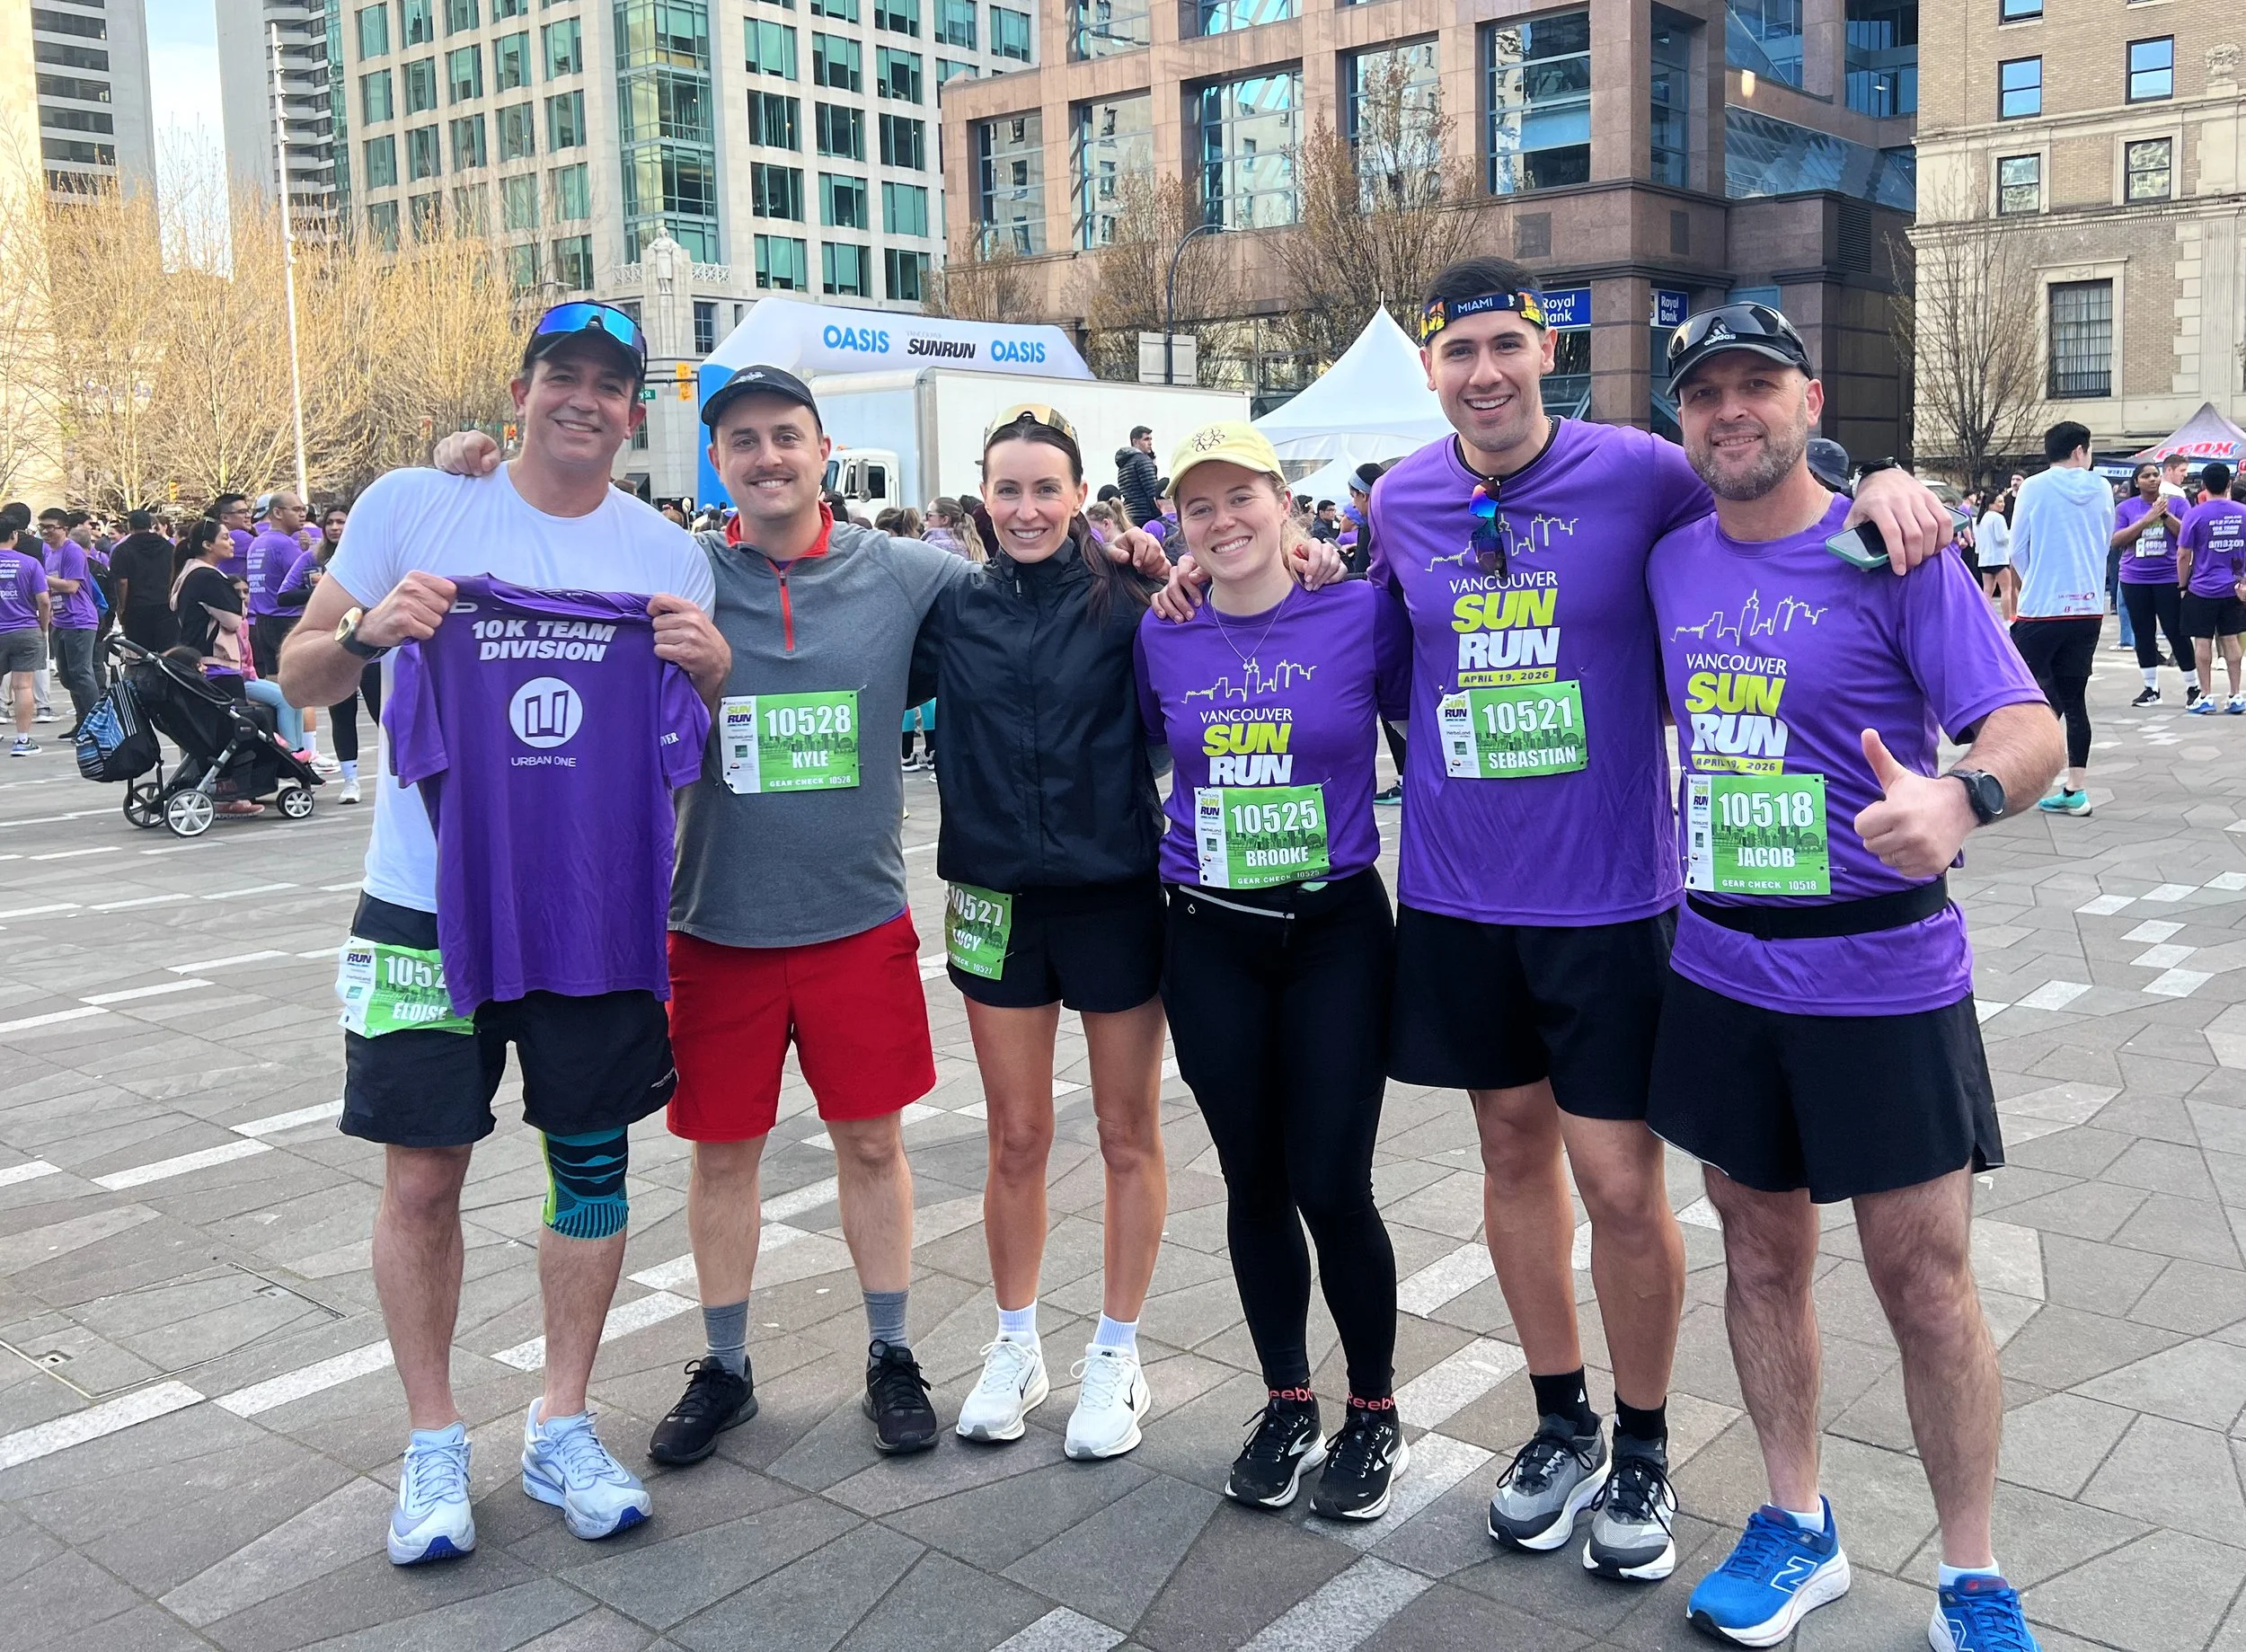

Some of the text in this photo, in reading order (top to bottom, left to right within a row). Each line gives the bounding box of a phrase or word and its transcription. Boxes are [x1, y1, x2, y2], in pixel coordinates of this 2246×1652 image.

[1457, 297, 1493, 314] MIAMI
[1661, 296, 1679, 311] Royal
[1661, 310, 1677, 322] Bank
[823, 325, 889, 353] OASIS
[907, 339, 976, 358] SUNRUN
[1704, 333, 1736, 346] adidas
[991, 340, 1046, 363] OASIS
[2208, 539, 2244, 549] amazon
[1449, 570, 1558, 594] VANCOUVER
[1451, 588, 1558, 633] SUN
[472, 620, 616, 642] 10K TEAM
[479, 640, 606, 662] DIVISION
[1458, 627, 1561, 670] RUN
[1685, 653, 1787, 676] VANCOUVER
[1463, 671, 1549, 684] APRIL 19, 2026
[1685, 672, 1786, 717] SUN
[727, 705, 751, 714] SUN
[727, 714, 751, 723] RUN
[1199, 708, 1293, 723] VANCOUVER
[1445, 709, 1467, 718] RUN
[1482, 696, 1573, 735] 10521
[765, 704, 852, 737] 10528
[1202, 722, 1292, 756] SUN
[1690, 713, 1789, 757] RUN
[511, 755, 576, 766] URBAN ONE
[792, 751, 829, 769] KYLE
[1488, 746, 1577, 770] SEBASTIAN
[1696, 758, 1725, 766] APRIL
[1746, 762, 1775, 771] 2026
[1209, 755, 1293, 786] RUN
[770, 780, 793, 788] GEAR
[829, 775, 851, 784] 10528
[1200, 798, 1219, 806] SUN
[1693, 796, 1709, 806] RUN
[1719, 791, 1814, 827] 10518
[1200, 807, 1219, 816] RUN
[1231, 799, 1318, 834] 10525
[1245, 846, 1309, 867] BROOKE
[1737, 847, 1796, 868] JACOB
[1238, 870, 1320, 885] GEAR CHECK 10525
[1721, 879, 1817, 890] GEAR CHECK 10518
[949, 885, 1004, 926] 10527
[953, 929, 982, 951] LUCY
[347, 953, 372, 964] RUN
[384, 956, 447, 988] 1052
[973, 964, 993, 975] 10527
[393, 1002, 447, 1021] ELOISE
